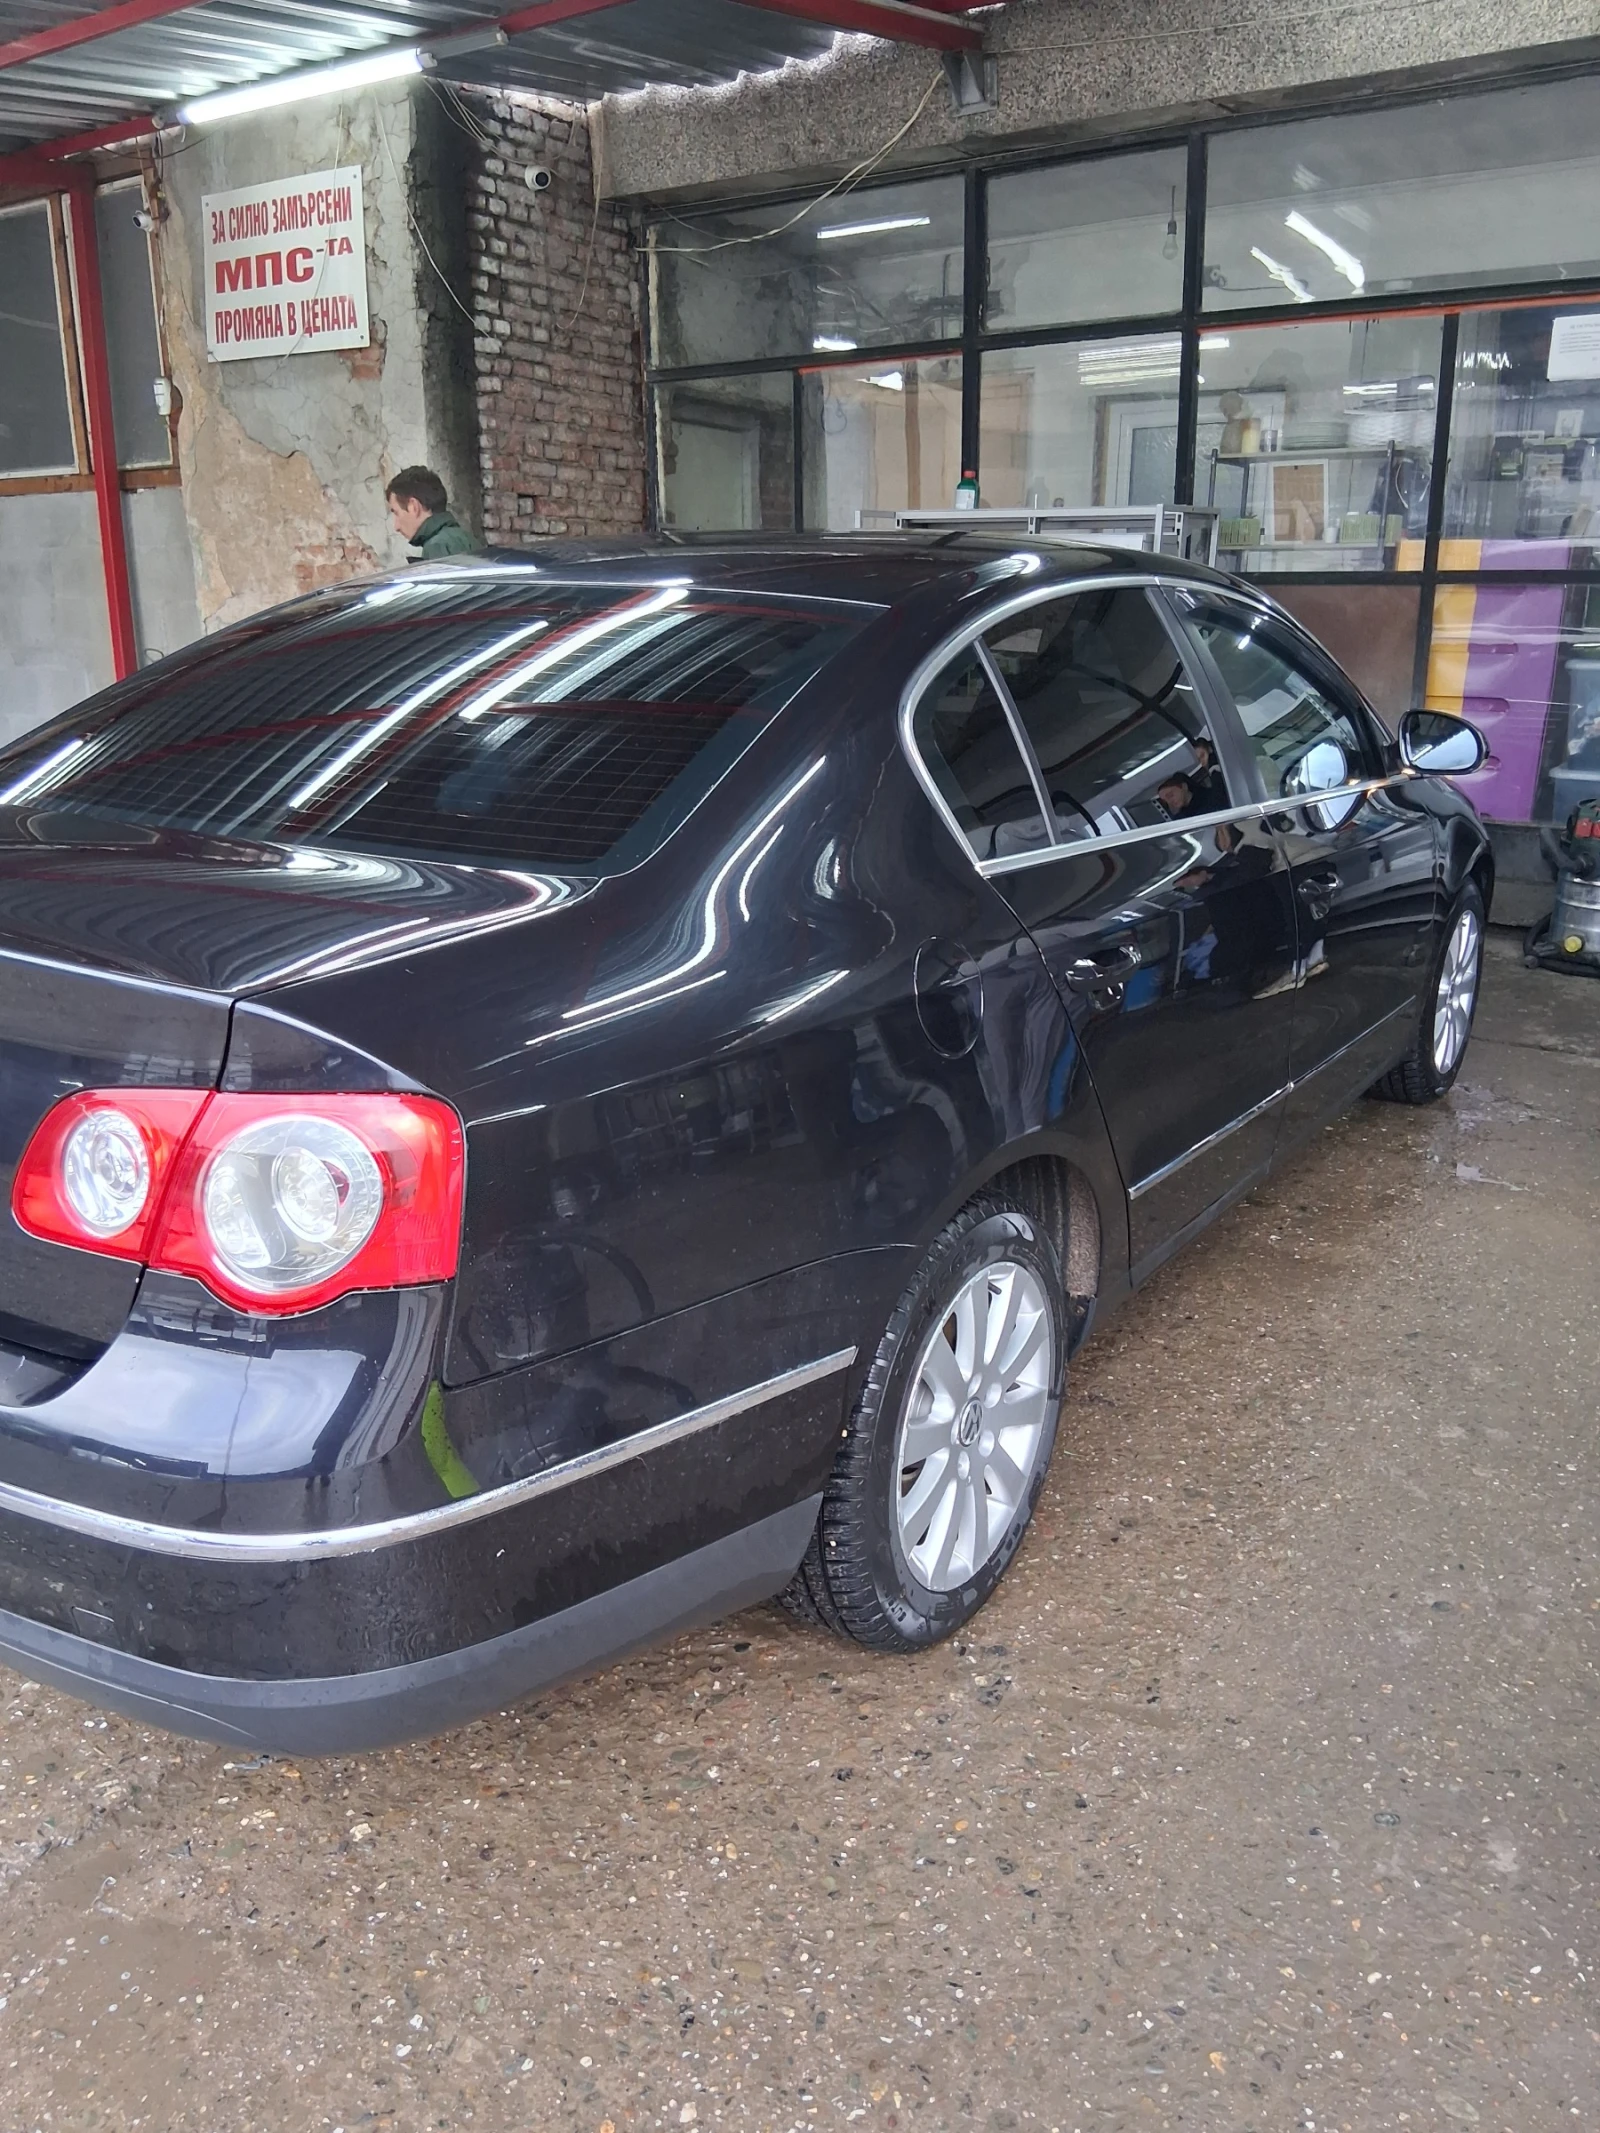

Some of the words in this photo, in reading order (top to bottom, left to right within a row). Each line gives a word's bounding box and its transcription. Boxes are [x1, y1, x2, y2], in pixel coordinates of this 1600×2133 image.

[211, 210, 227, 245] ЗА
[229, 200, 269, 242] СИЛНО
[272, 186, 353, 234] ЗАМЪРСЕНИ
[215, 303, 284, 344] ПРОМЯНА
[286, 301, 297, 336] В
[301, 294, 358, 338] ЦЕНАТА
